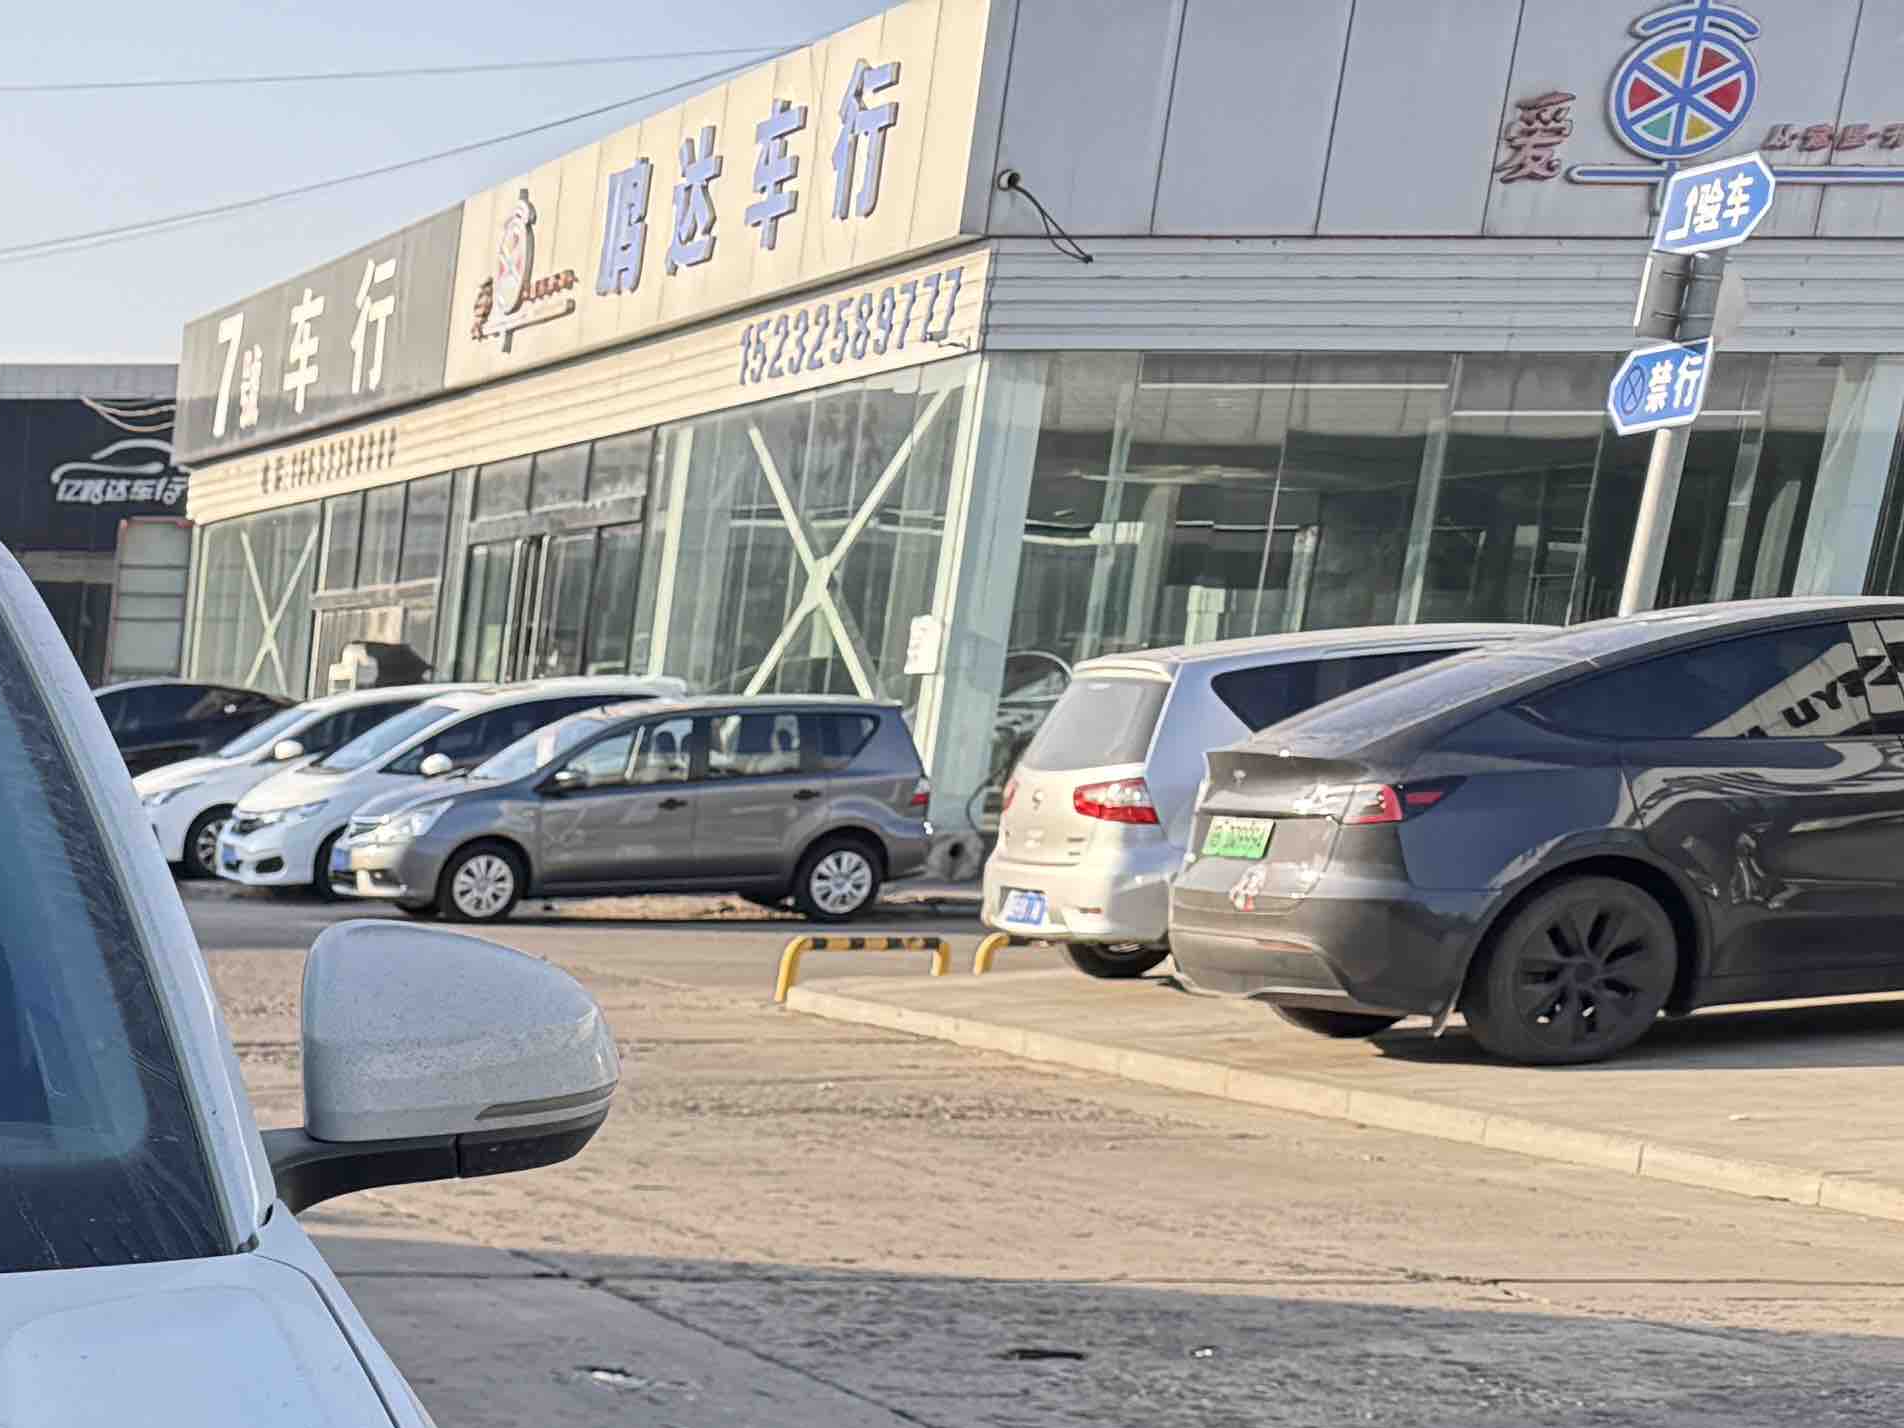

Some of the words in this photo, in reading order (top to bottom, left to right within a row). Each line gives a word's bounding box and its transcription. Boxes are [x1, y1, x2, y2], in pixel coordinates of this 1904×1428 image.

[595, 57, 901, 297] 鹏达车行
[1692, 174, 1754, 233] 验车
[739, 265, 965, 385] 15232589777
[1645, 355, 1704, 414] 禁行
